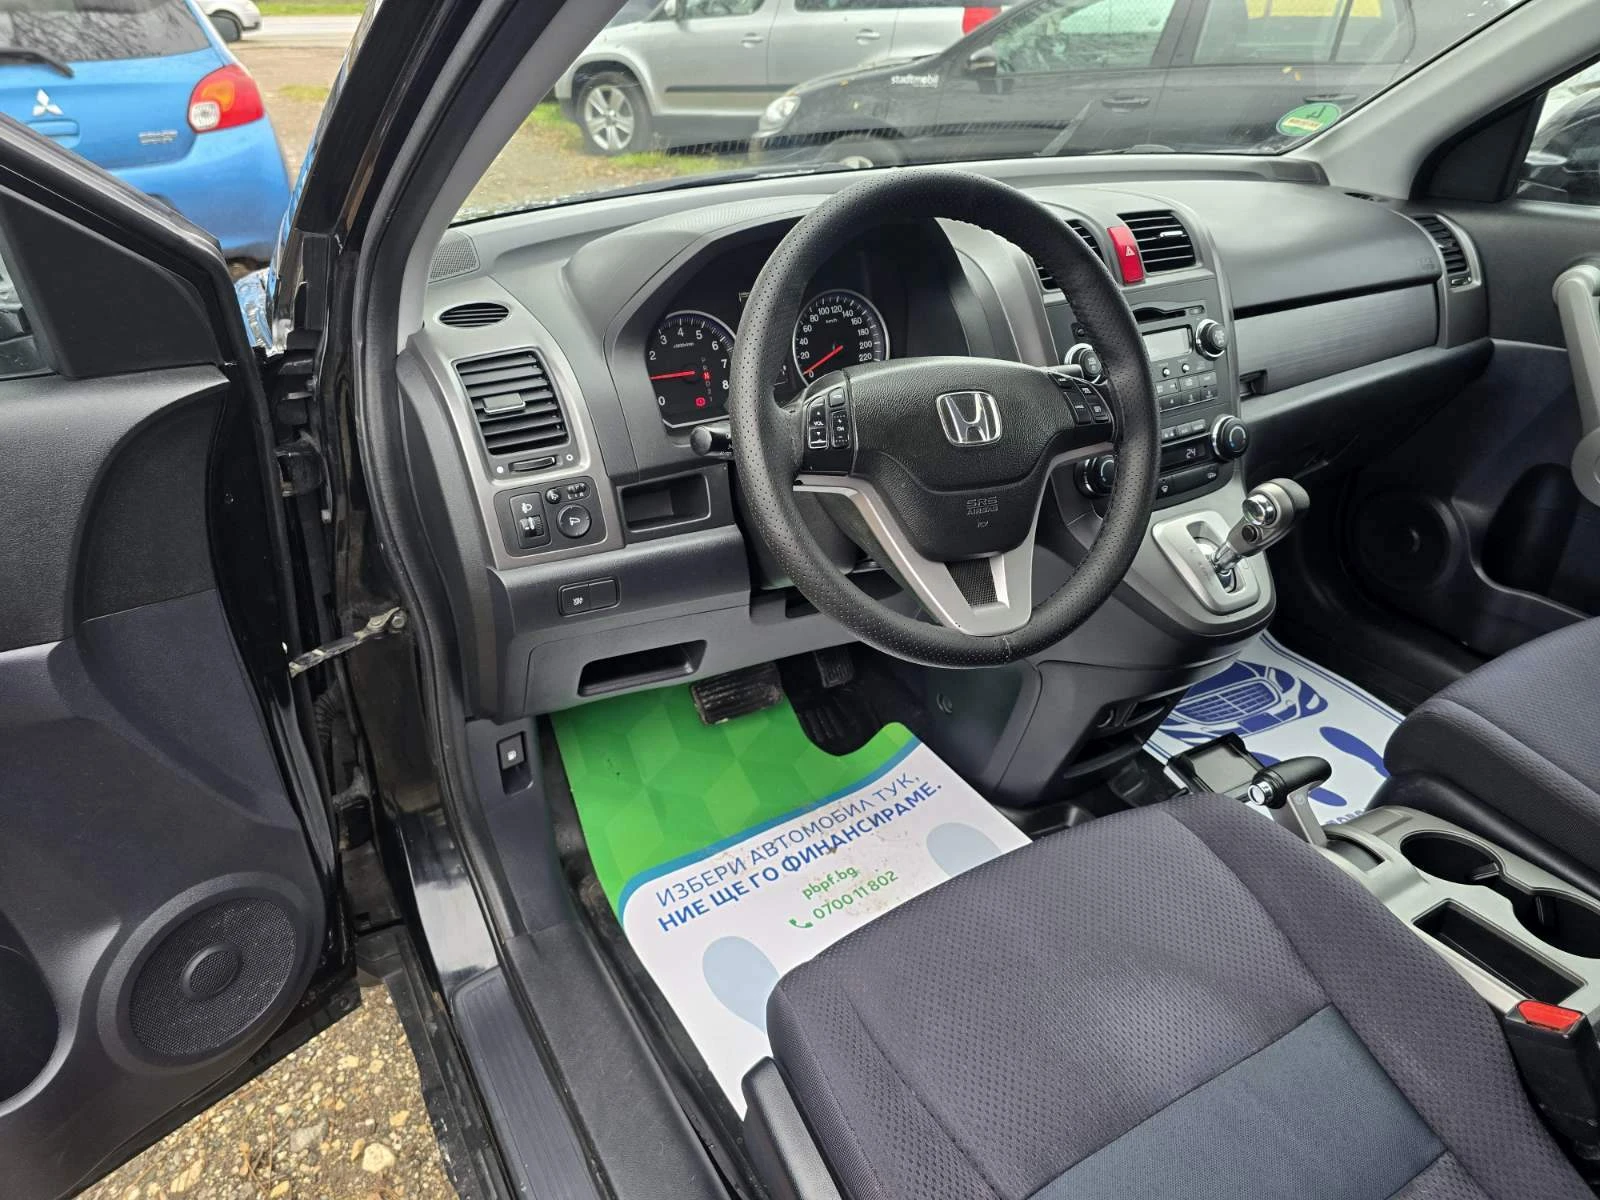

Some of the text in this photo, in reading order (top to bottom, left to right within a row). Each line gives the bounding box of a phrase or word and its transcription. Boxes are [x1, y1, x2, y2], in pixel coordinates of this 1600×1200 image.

[818, 306, 830, 316] 100
[830, 305, 843, 314] 120
[842, 309, 854, 318] 140
[809, 314, 819, 323] 80
[851, 317, 863, 325] 160
[677, 327, 684, 337] 4
[803, 325, 812, 333] 60
[857, 328, 870, 336] 180
[660, 334, 668, 345] 3
[695, 330, 703, 340] 5
[711, 340, 719, 351] 6
[799, 337, 808, 346] 40
[859, 340, 873, 349] 200
[649, 350, 657, 361] 2
[800, 351, 810, 360] 20
[858, 353, 872, 362] 220
[720, 358, 728, 369] 7
[722, 379, 729, 390] 8
[658, 395, 666, 406] 0
[1186, 448, 1196, 459] 24
[966, 496, 998, 507] SRS
[656, 773, 920, 908] ИЗБЕРИ АВТОМОБИЛ ТУК,
[658, 782, 942, 932] НИЕ ЩЕ ГО ФИНАНСИРАМЕ.
[802, 867, 858, 900] pbpf.bg
[813, 870, 898, 919] 0700 11 802
